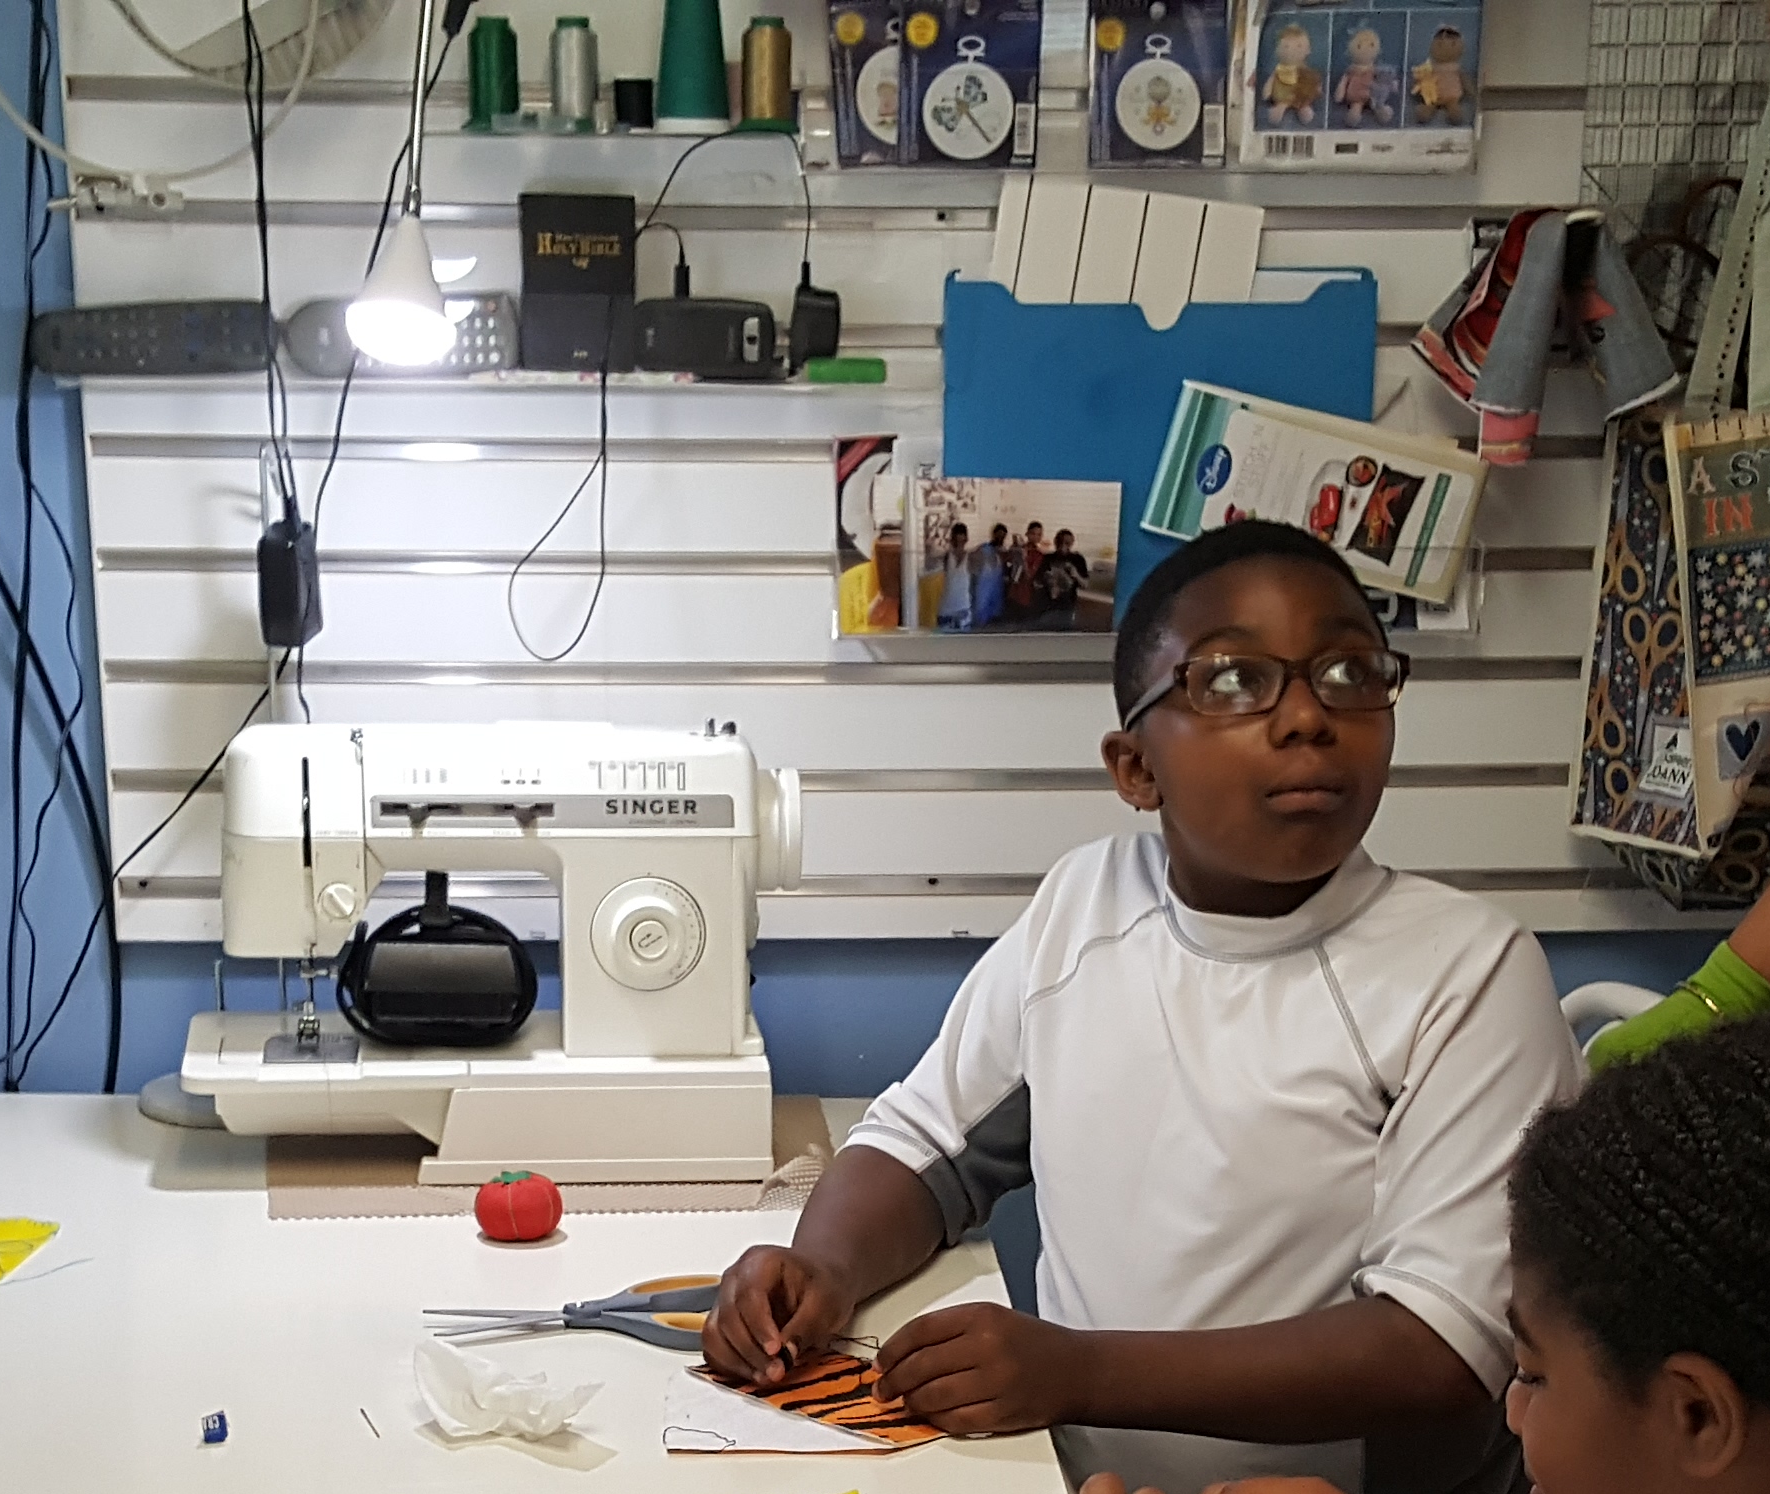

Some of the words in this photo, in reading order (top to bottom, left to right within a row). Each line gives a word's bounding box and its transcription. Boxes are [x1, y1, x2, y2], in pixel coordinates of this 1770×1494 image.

[536, 232, 577, 255] HOLY
[578, 241, 622, 256] BIBLE
[1199, 447, 1228, 490] Disney
[1686, 455, 1717, 495] A
[1703, 495, 1753, 537] IN
[605, 798, 698, 815] SINGER
